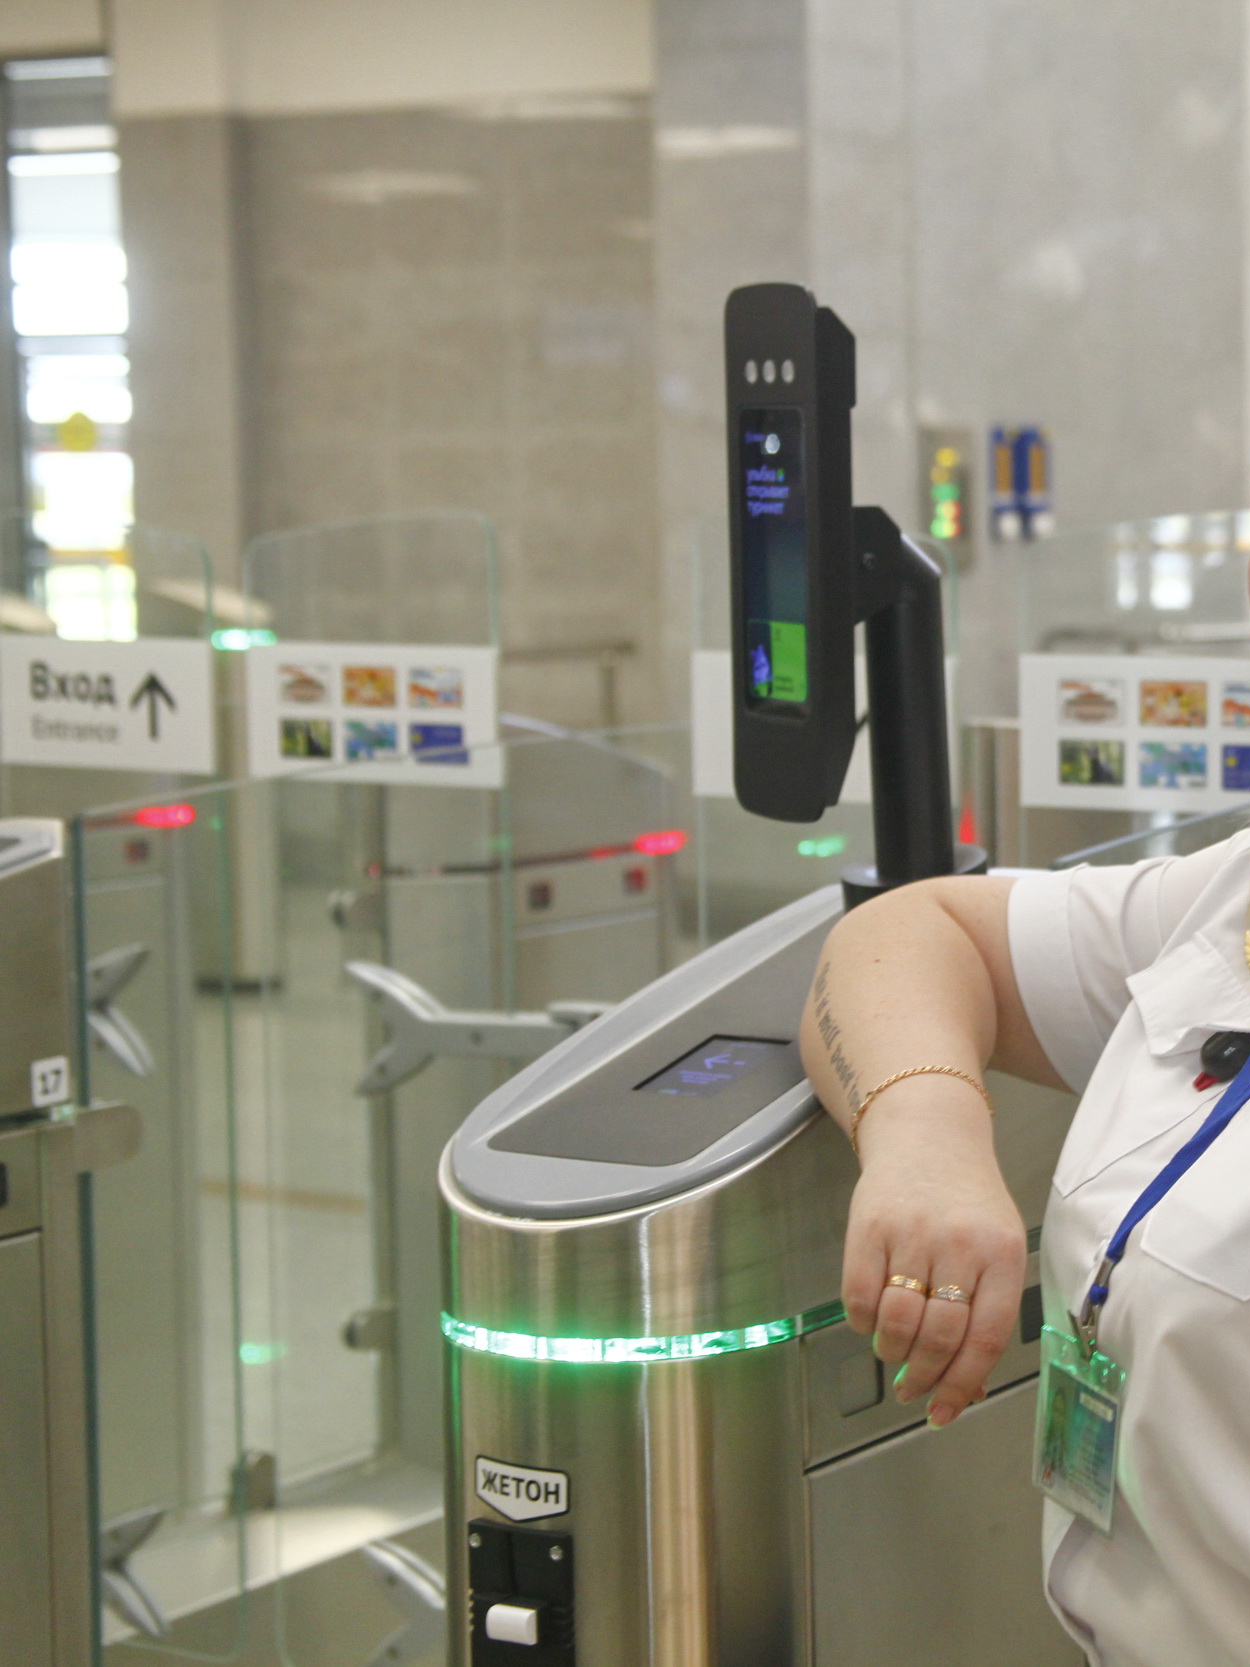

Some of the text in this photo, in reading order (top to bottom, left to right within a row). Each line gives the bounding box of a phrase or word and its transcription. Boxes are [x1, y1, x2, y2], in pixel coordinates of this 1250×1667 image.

[30, 660, 117, 707] Вход
[39, 1067, 61, 1096] 17
[481, 1468, 560, 1505] ЖЕТОН
